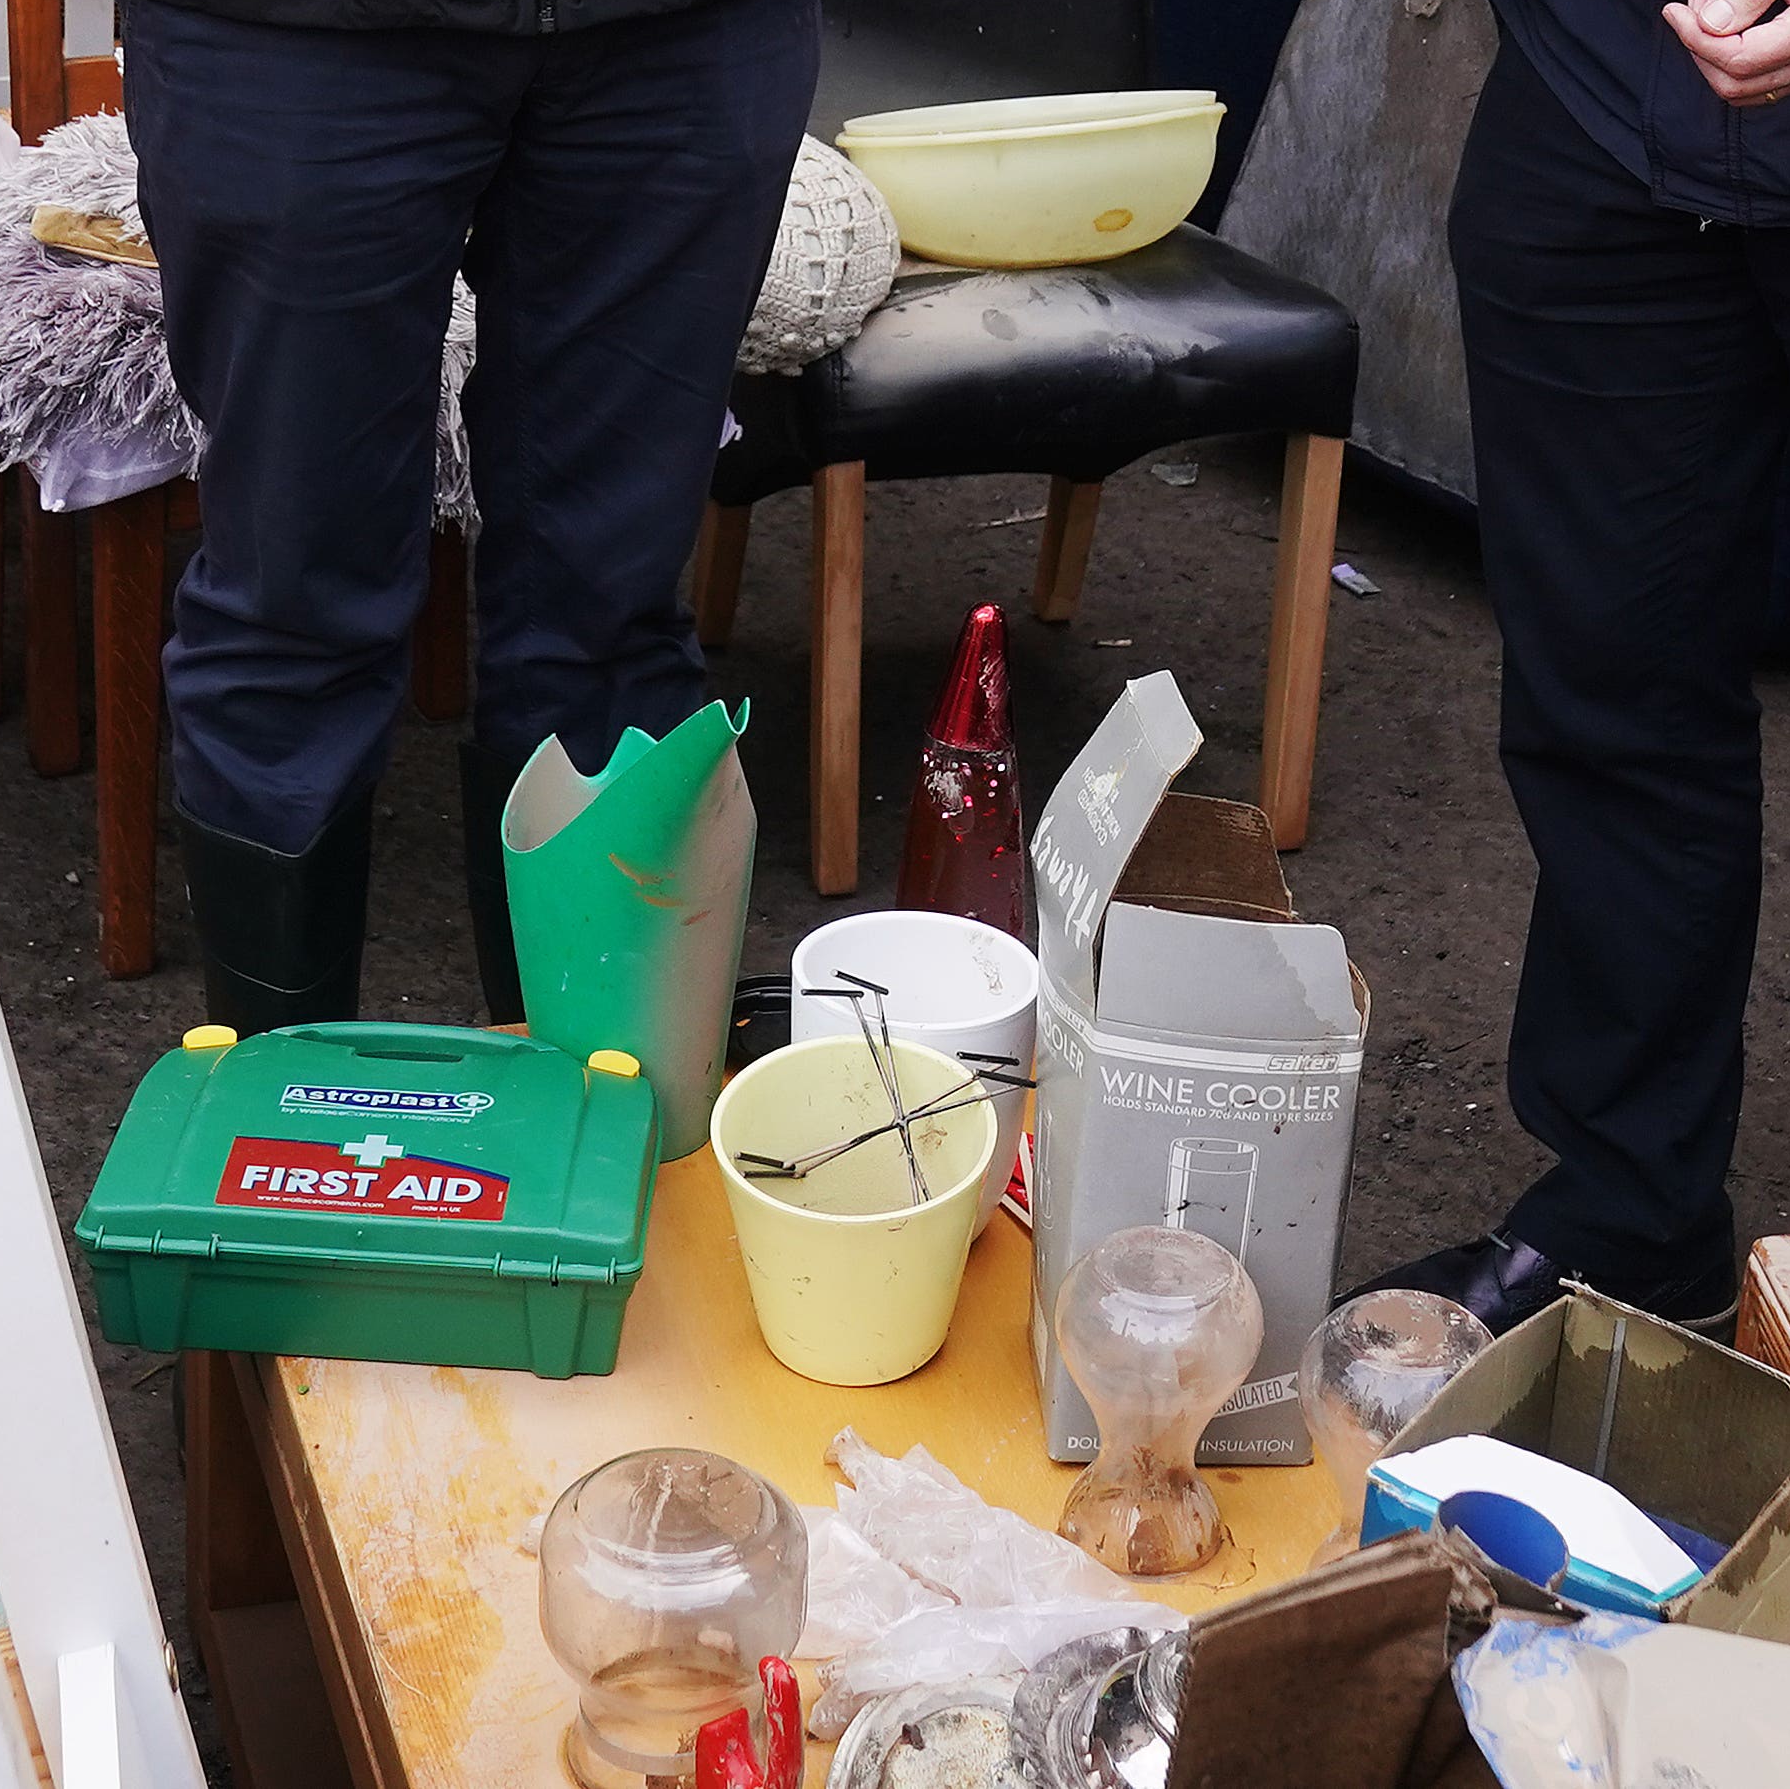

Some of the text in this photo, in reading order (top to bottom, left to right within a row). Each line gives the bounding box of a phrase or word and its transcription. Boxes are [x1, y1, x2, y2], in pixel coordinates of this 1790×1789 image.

[1042, 1011, 1084, 1079] OOLER
[1269, 1054, 1338, 1072] salter
[286, 1087, 450, 1108] Astroplast
[1099, 1065, 1340, 1111] WINE COOLER
[1102, 1094, 1142, 1110] HOLDS
[1144, 1100, 1207, 1118] STANDARD
[1232, 1111, 1261, 1122] AND
[1303, 1111, 1334, 1122] SIZES
[240, 1165, 379, 1198] FIRST
[388, 1175, 482, 1204] AID
[1200, 1438, 1295, 1453] INSULATION
